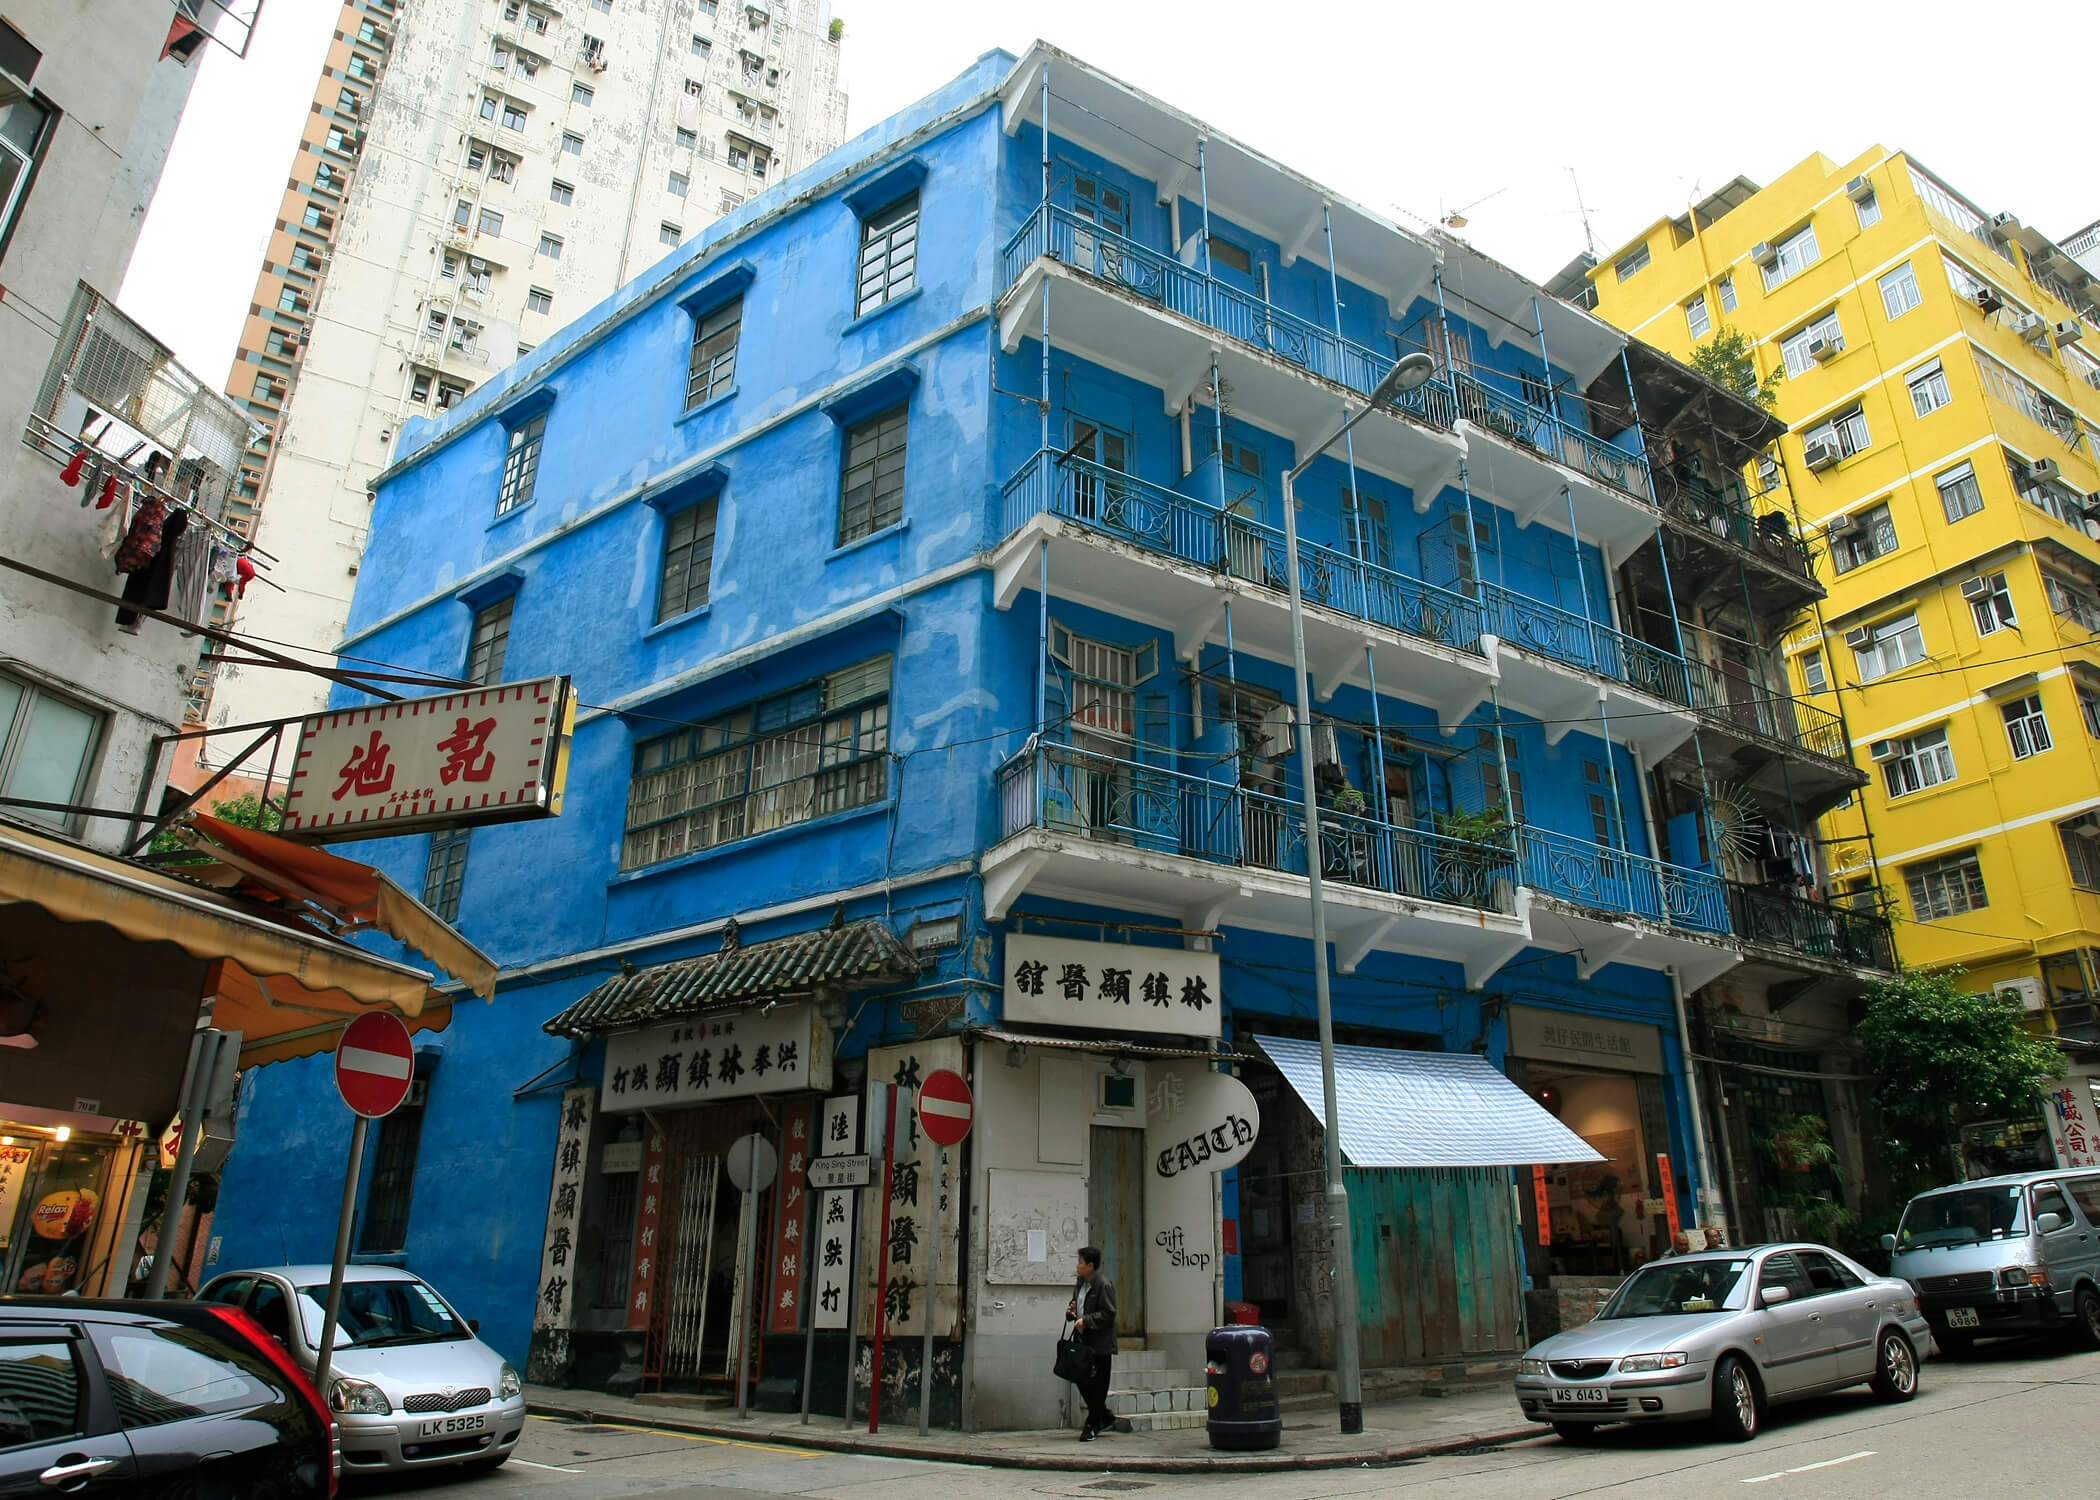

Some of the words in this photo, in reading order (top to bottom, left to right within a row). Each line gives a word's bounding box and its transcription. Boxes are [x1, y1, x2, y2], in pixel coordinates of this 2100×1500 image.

[332, 717, 497, 801] 池記
[815, 1160, 830, 1170] King
[831, 1159, 846, 1170] Sing
[847, 1158, 868, 1168] Street
[38, 1203, 67, 1214] Relax
[820, 1111, 849, 1312] 陸燕跌打
[1156, 1226, 1184, 1253] Gift
[1171, 1248, 1210, 1270] Shop
[1557, 1390, 1571, 1400] MS
[1577, 1389, 1603, 1400] 6143
[422, 1421, 441, 1435] LK
[446, 1416, 484, 1432] 5325
